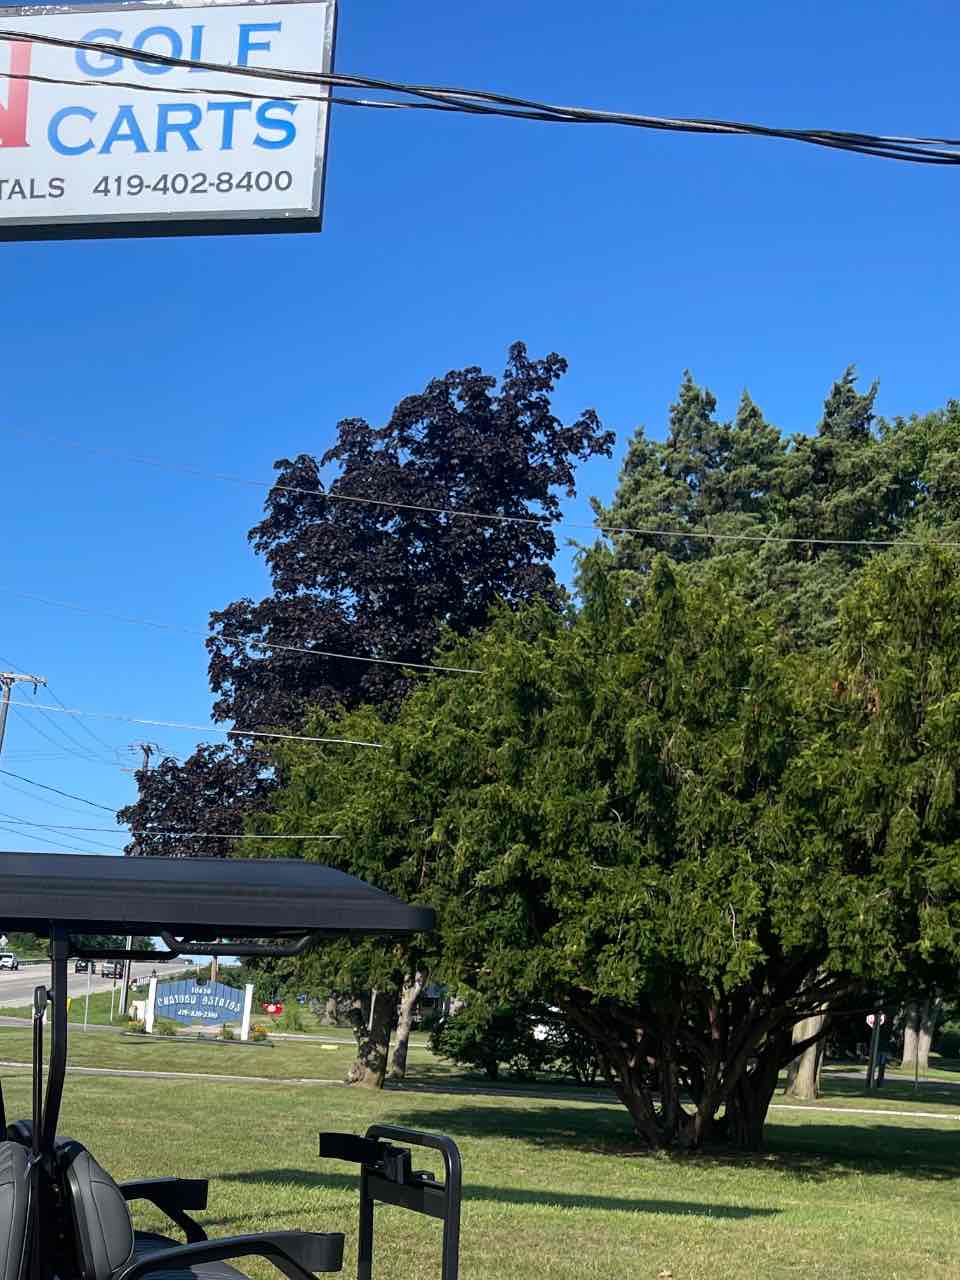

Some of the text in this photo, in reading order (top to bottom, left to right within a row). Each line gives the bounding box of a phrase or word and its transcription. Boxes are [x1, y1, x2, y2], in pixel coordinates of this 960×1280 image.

[75, 21, 283, 78] GOLF
[47, 99, 300, 156] CARTS
[93, 170, 293, 197] 419-402-8400
